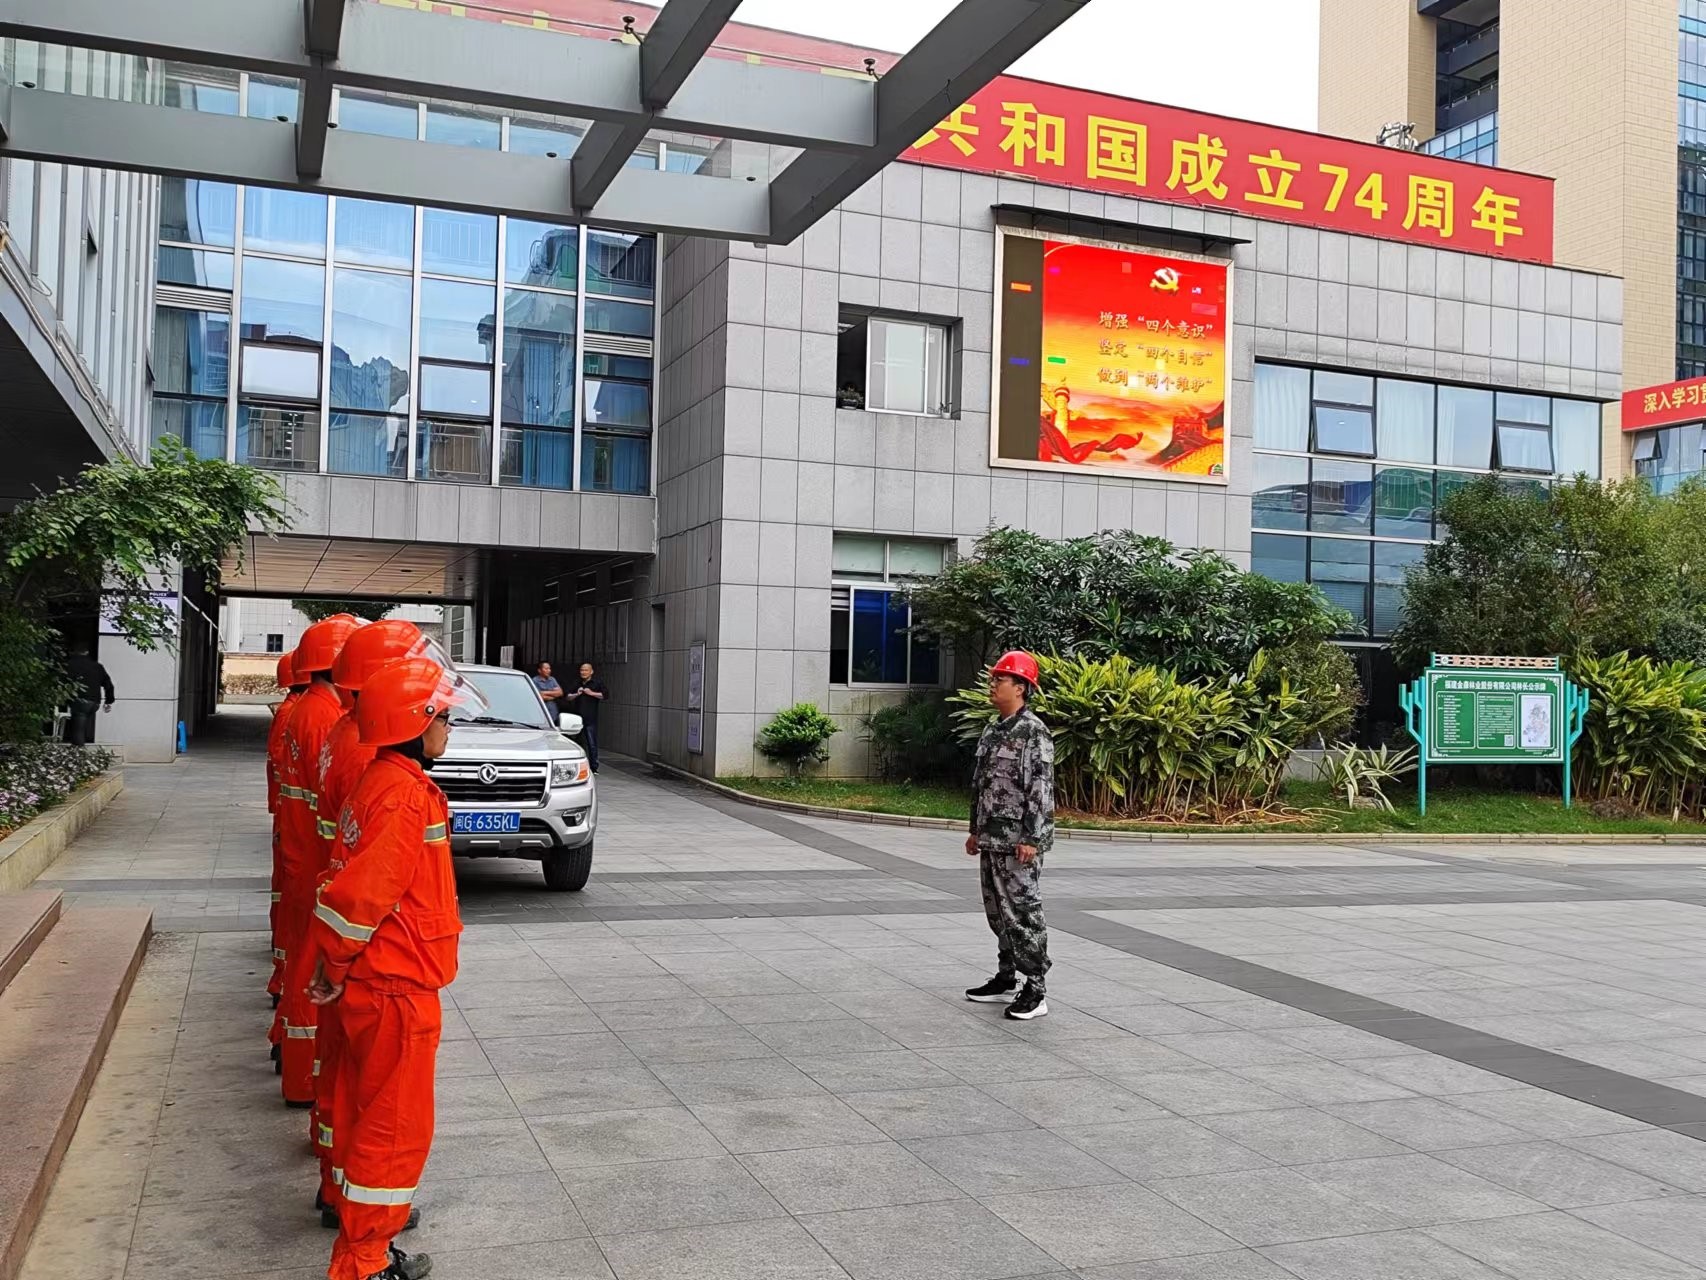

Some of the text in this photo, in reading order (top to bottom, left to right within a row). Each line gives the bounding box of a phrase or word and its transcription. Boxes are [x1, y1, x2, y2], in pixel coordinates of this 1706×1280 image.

[912, 102, 1524, 246] 共和国成立74周年
